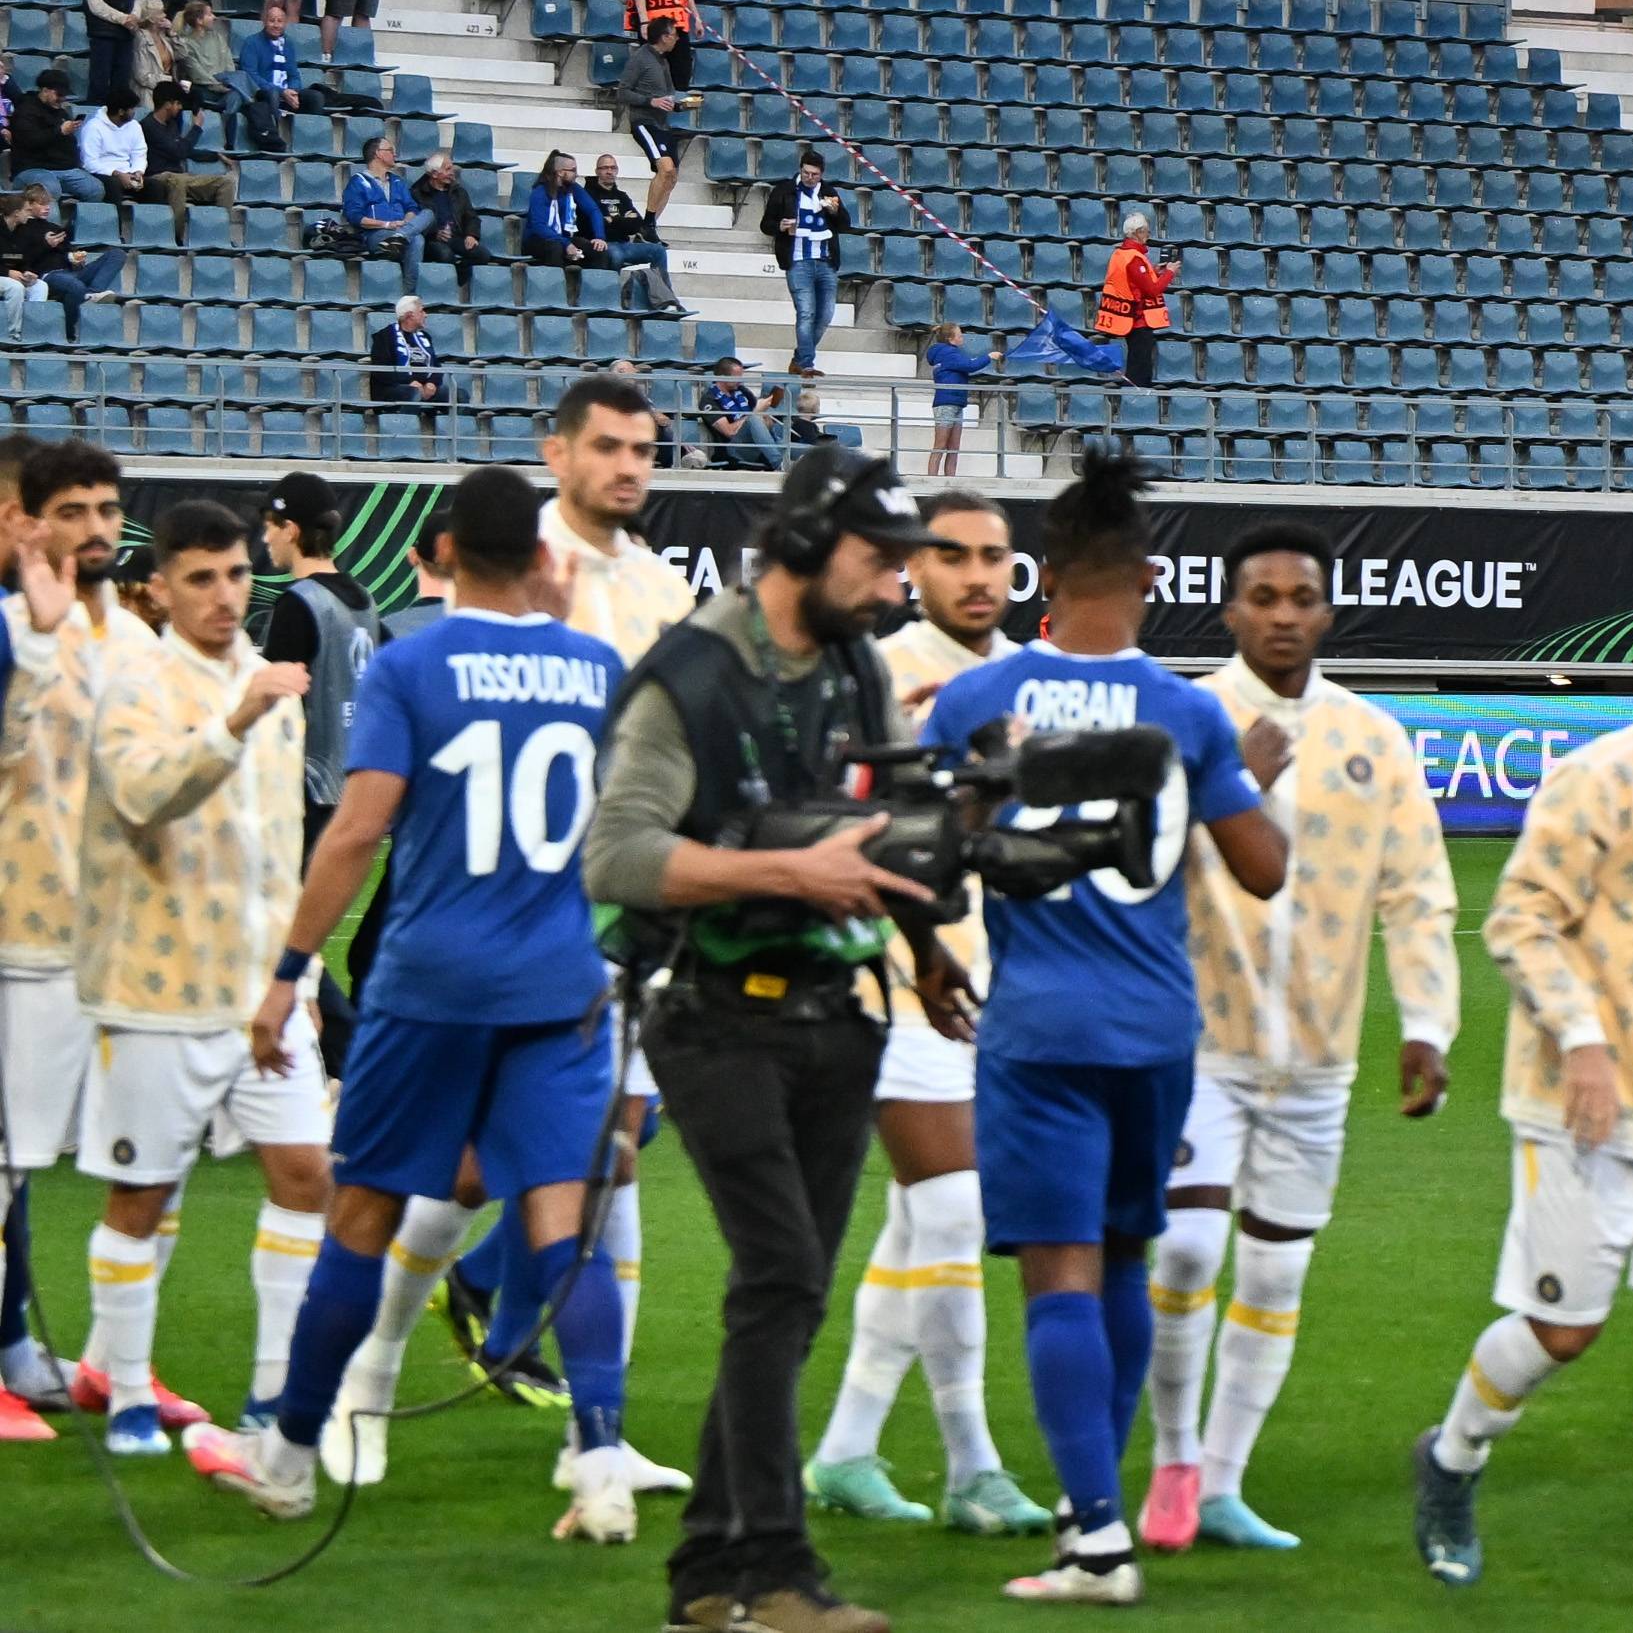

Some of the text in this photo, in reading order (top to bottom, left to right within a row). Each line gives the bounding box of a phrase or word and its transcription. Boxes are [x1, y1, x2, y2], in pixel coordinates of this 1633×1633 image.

[386, 20, 480, 33] VAK 423
[682, 260, 775, 272] VAK 423
[448, 653, 607, 709] TISSOUDALI
[1014, 678, 1137, 729] ORBAN
[1416, 727, 1571, 800] EACE
[430, 719, 598, 877] 10
